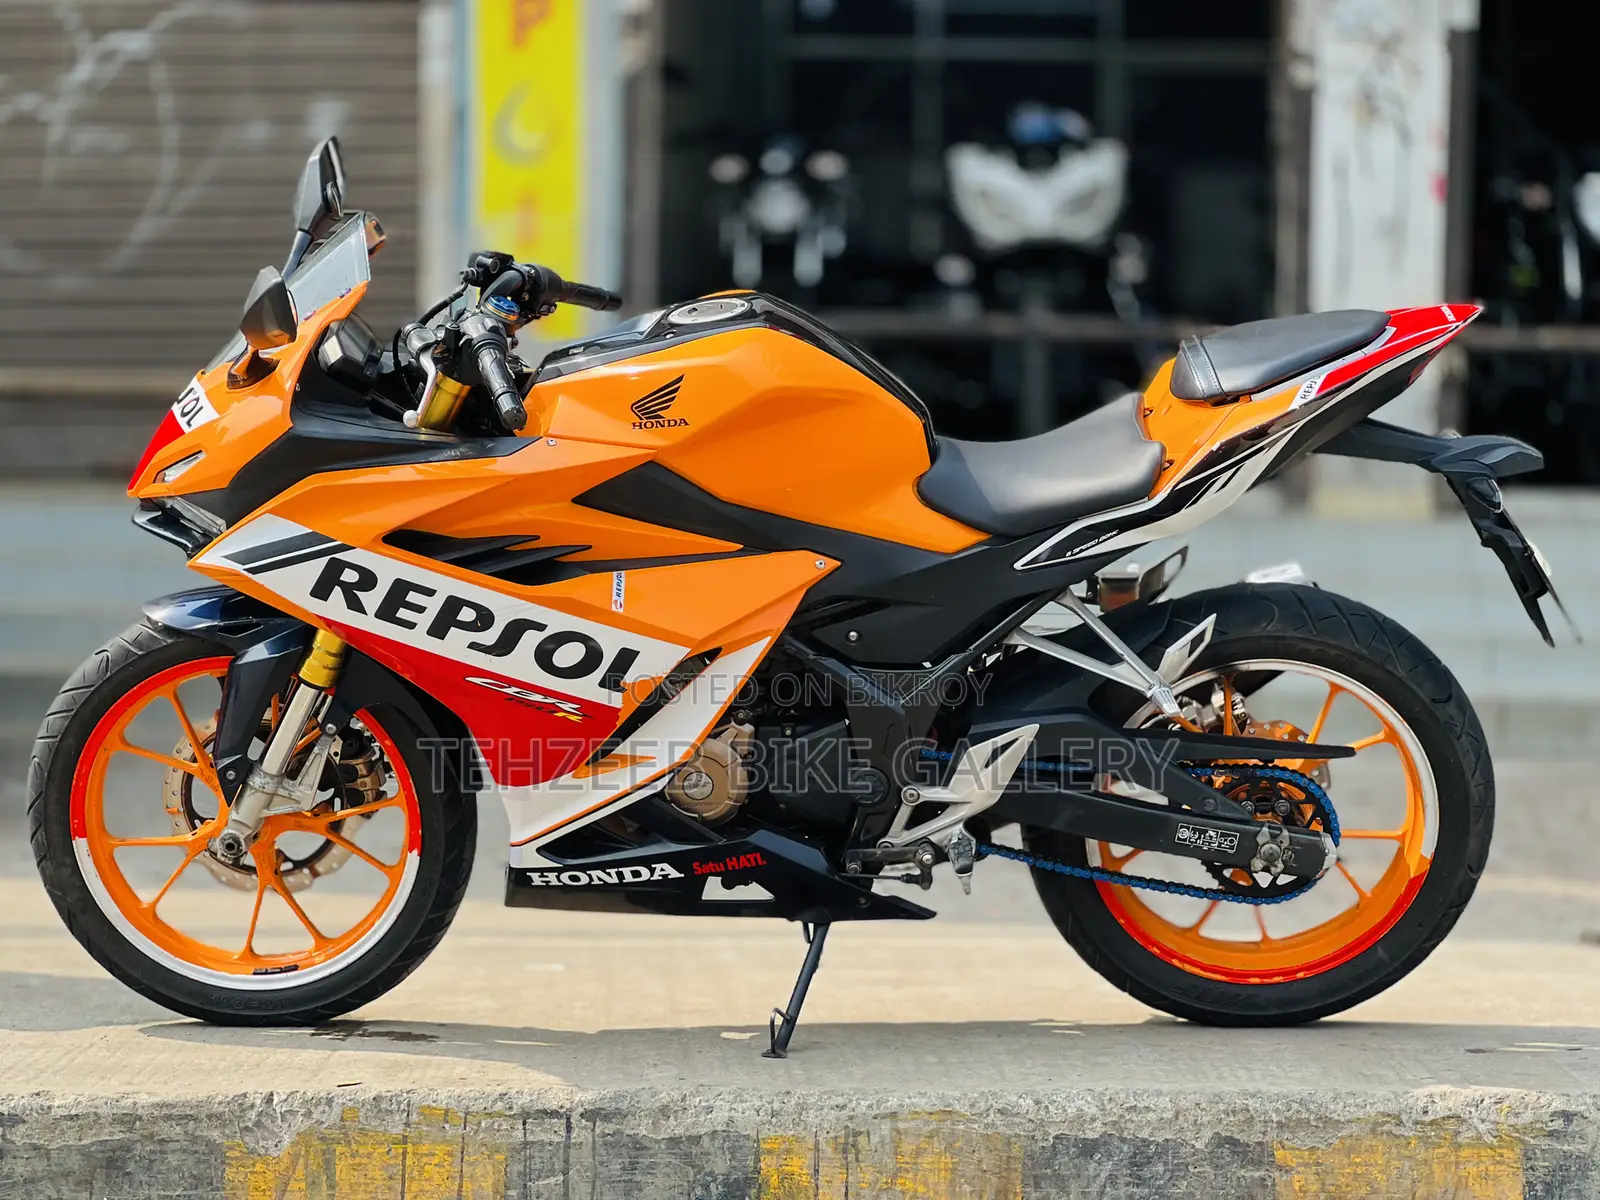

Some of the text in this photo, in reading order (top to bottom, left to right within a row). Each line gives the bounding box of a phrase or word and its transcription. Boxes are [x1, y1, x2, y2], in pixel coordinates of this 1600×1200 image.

[631, 418, 690, 430] HONDA
[1073, 539, 1098, 554] SPEED
[309, 556, 641, 693] REPSOL
[463, 676, 584, 717] CBR
[526, 862, 685, 886] HONDA
[692, 860, 725, 875] Satu
